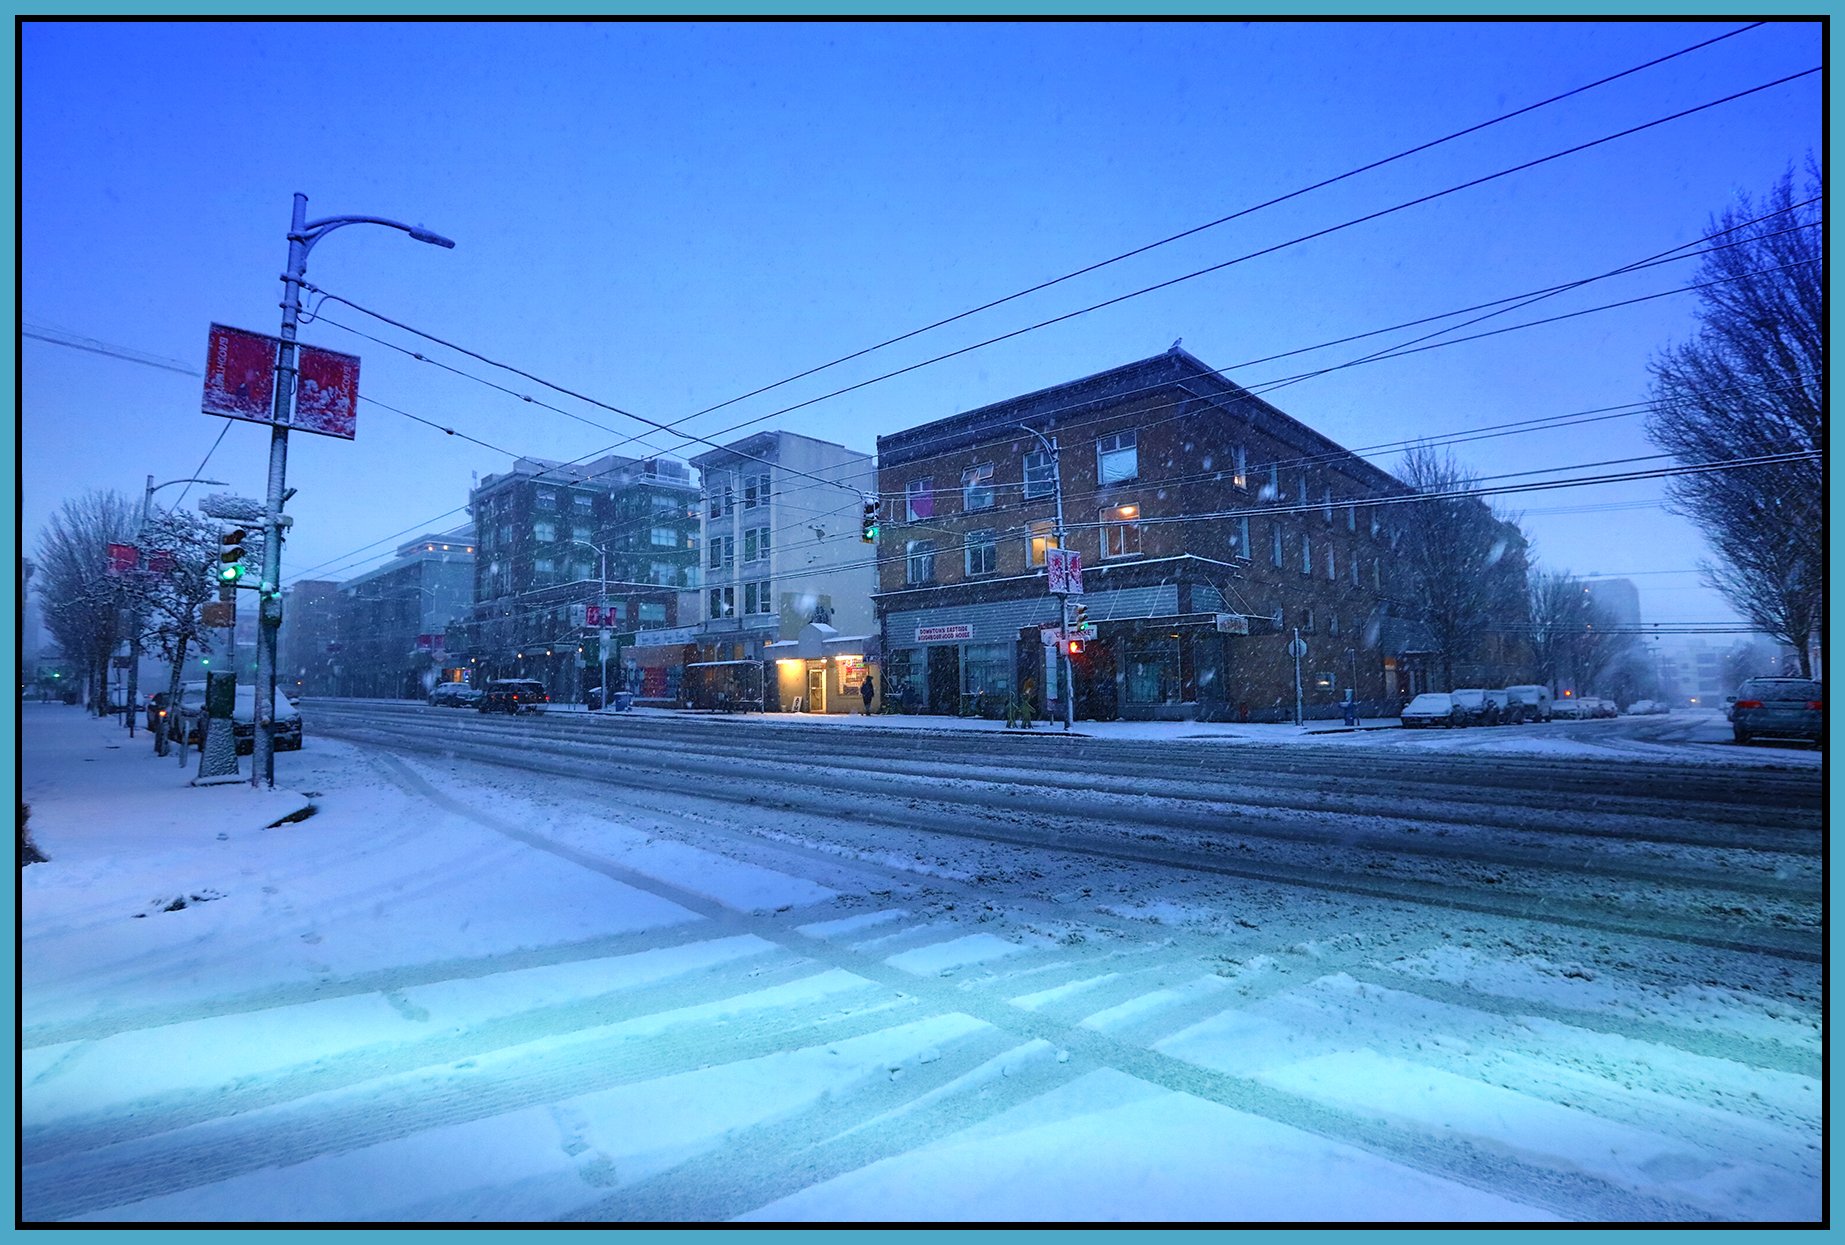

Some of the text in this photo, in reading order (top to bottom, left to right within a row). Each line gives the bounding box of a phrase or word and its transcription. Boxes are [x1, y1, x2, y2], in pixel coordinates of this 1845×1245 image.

[919, 625, 968, 635] DOWNTOWN EASTSIDE
[917, 631, 970, 641] NEIGHBOURHOOD HOUSE
